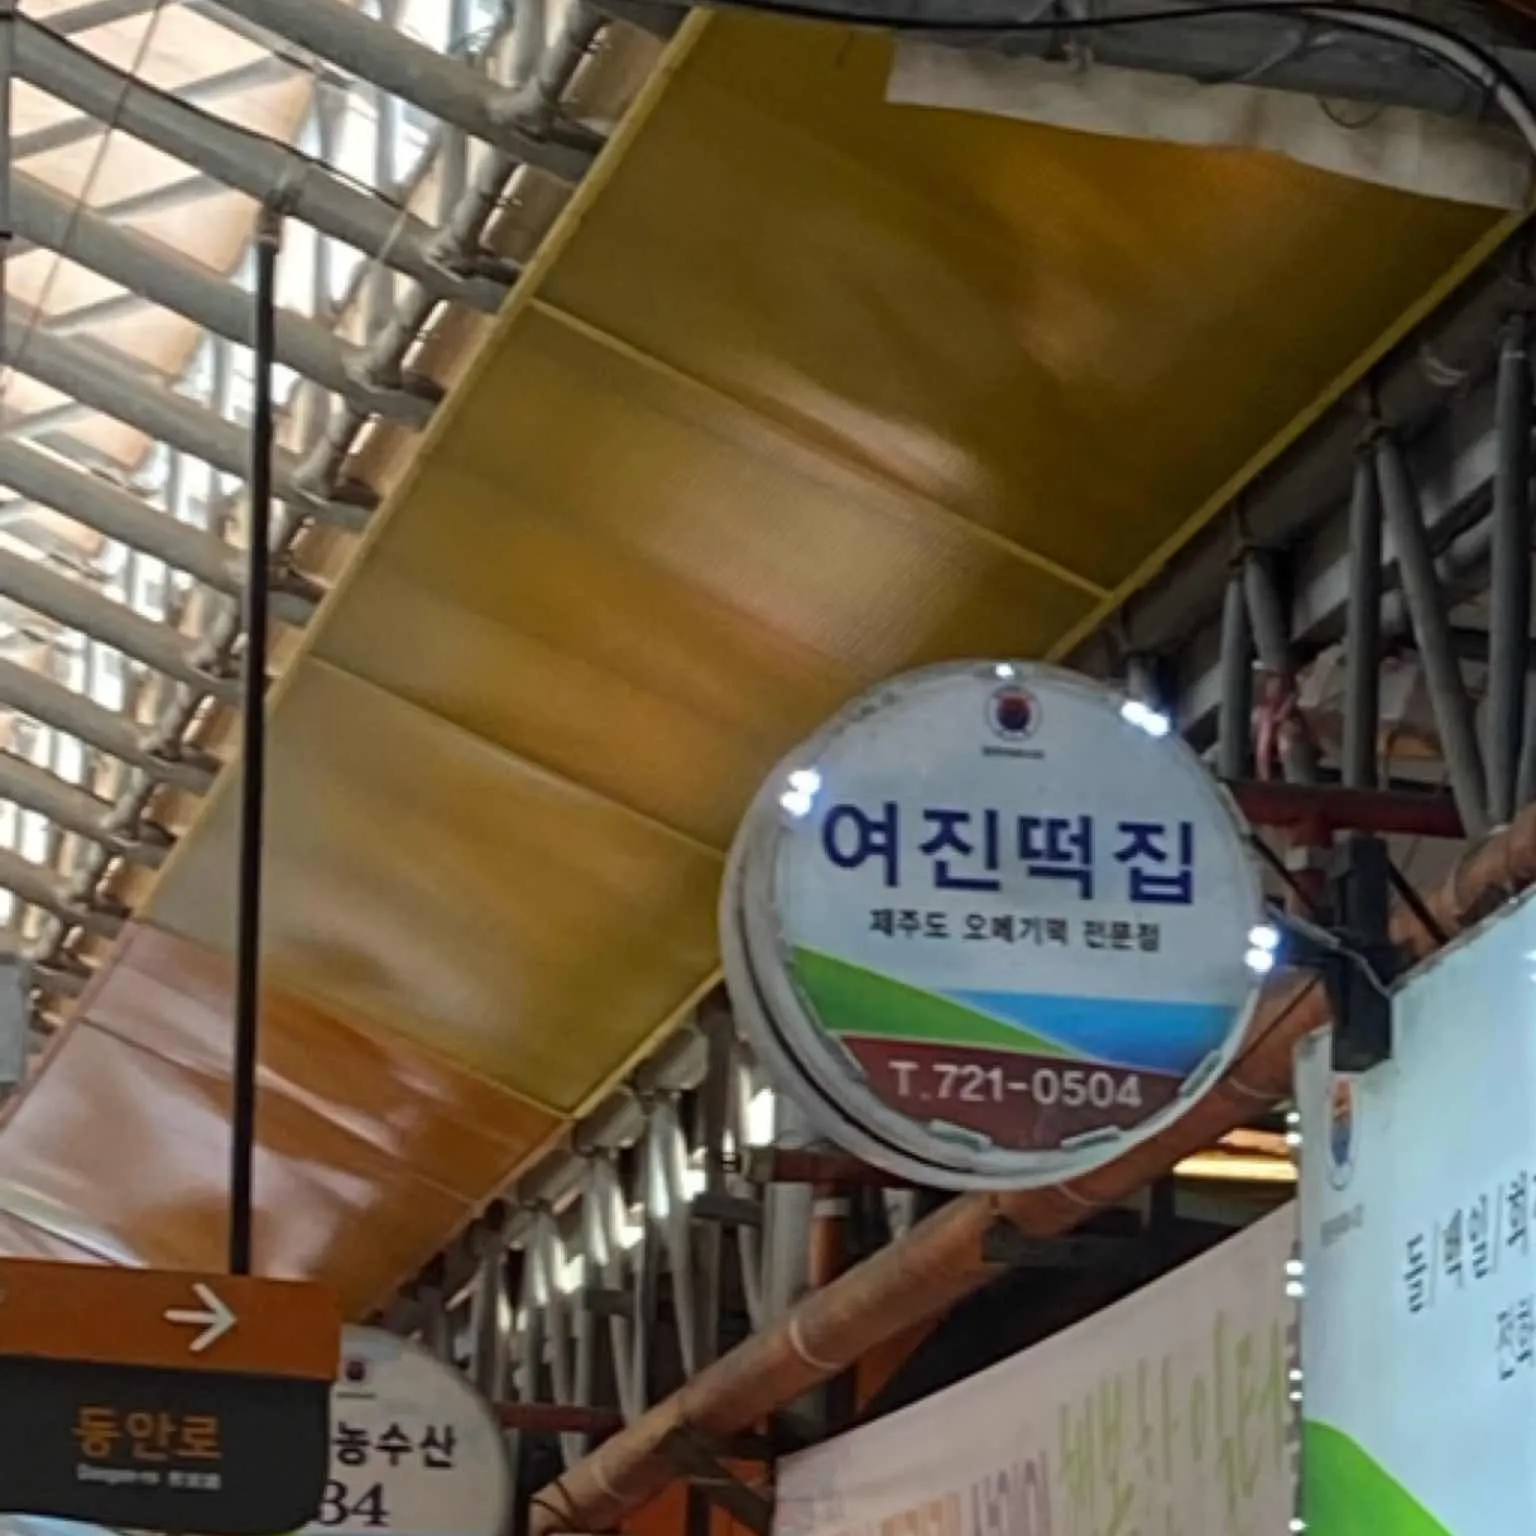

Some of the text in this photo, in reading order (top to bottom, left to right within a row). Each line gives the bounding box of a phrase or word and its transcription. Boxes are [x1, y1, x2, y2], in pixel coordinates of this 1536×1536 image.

[822, 801, 1195, 905] 여진떡집
[869, 908, 949, 939] 제주도
[73, 1404, 222, 1461] 동안로
